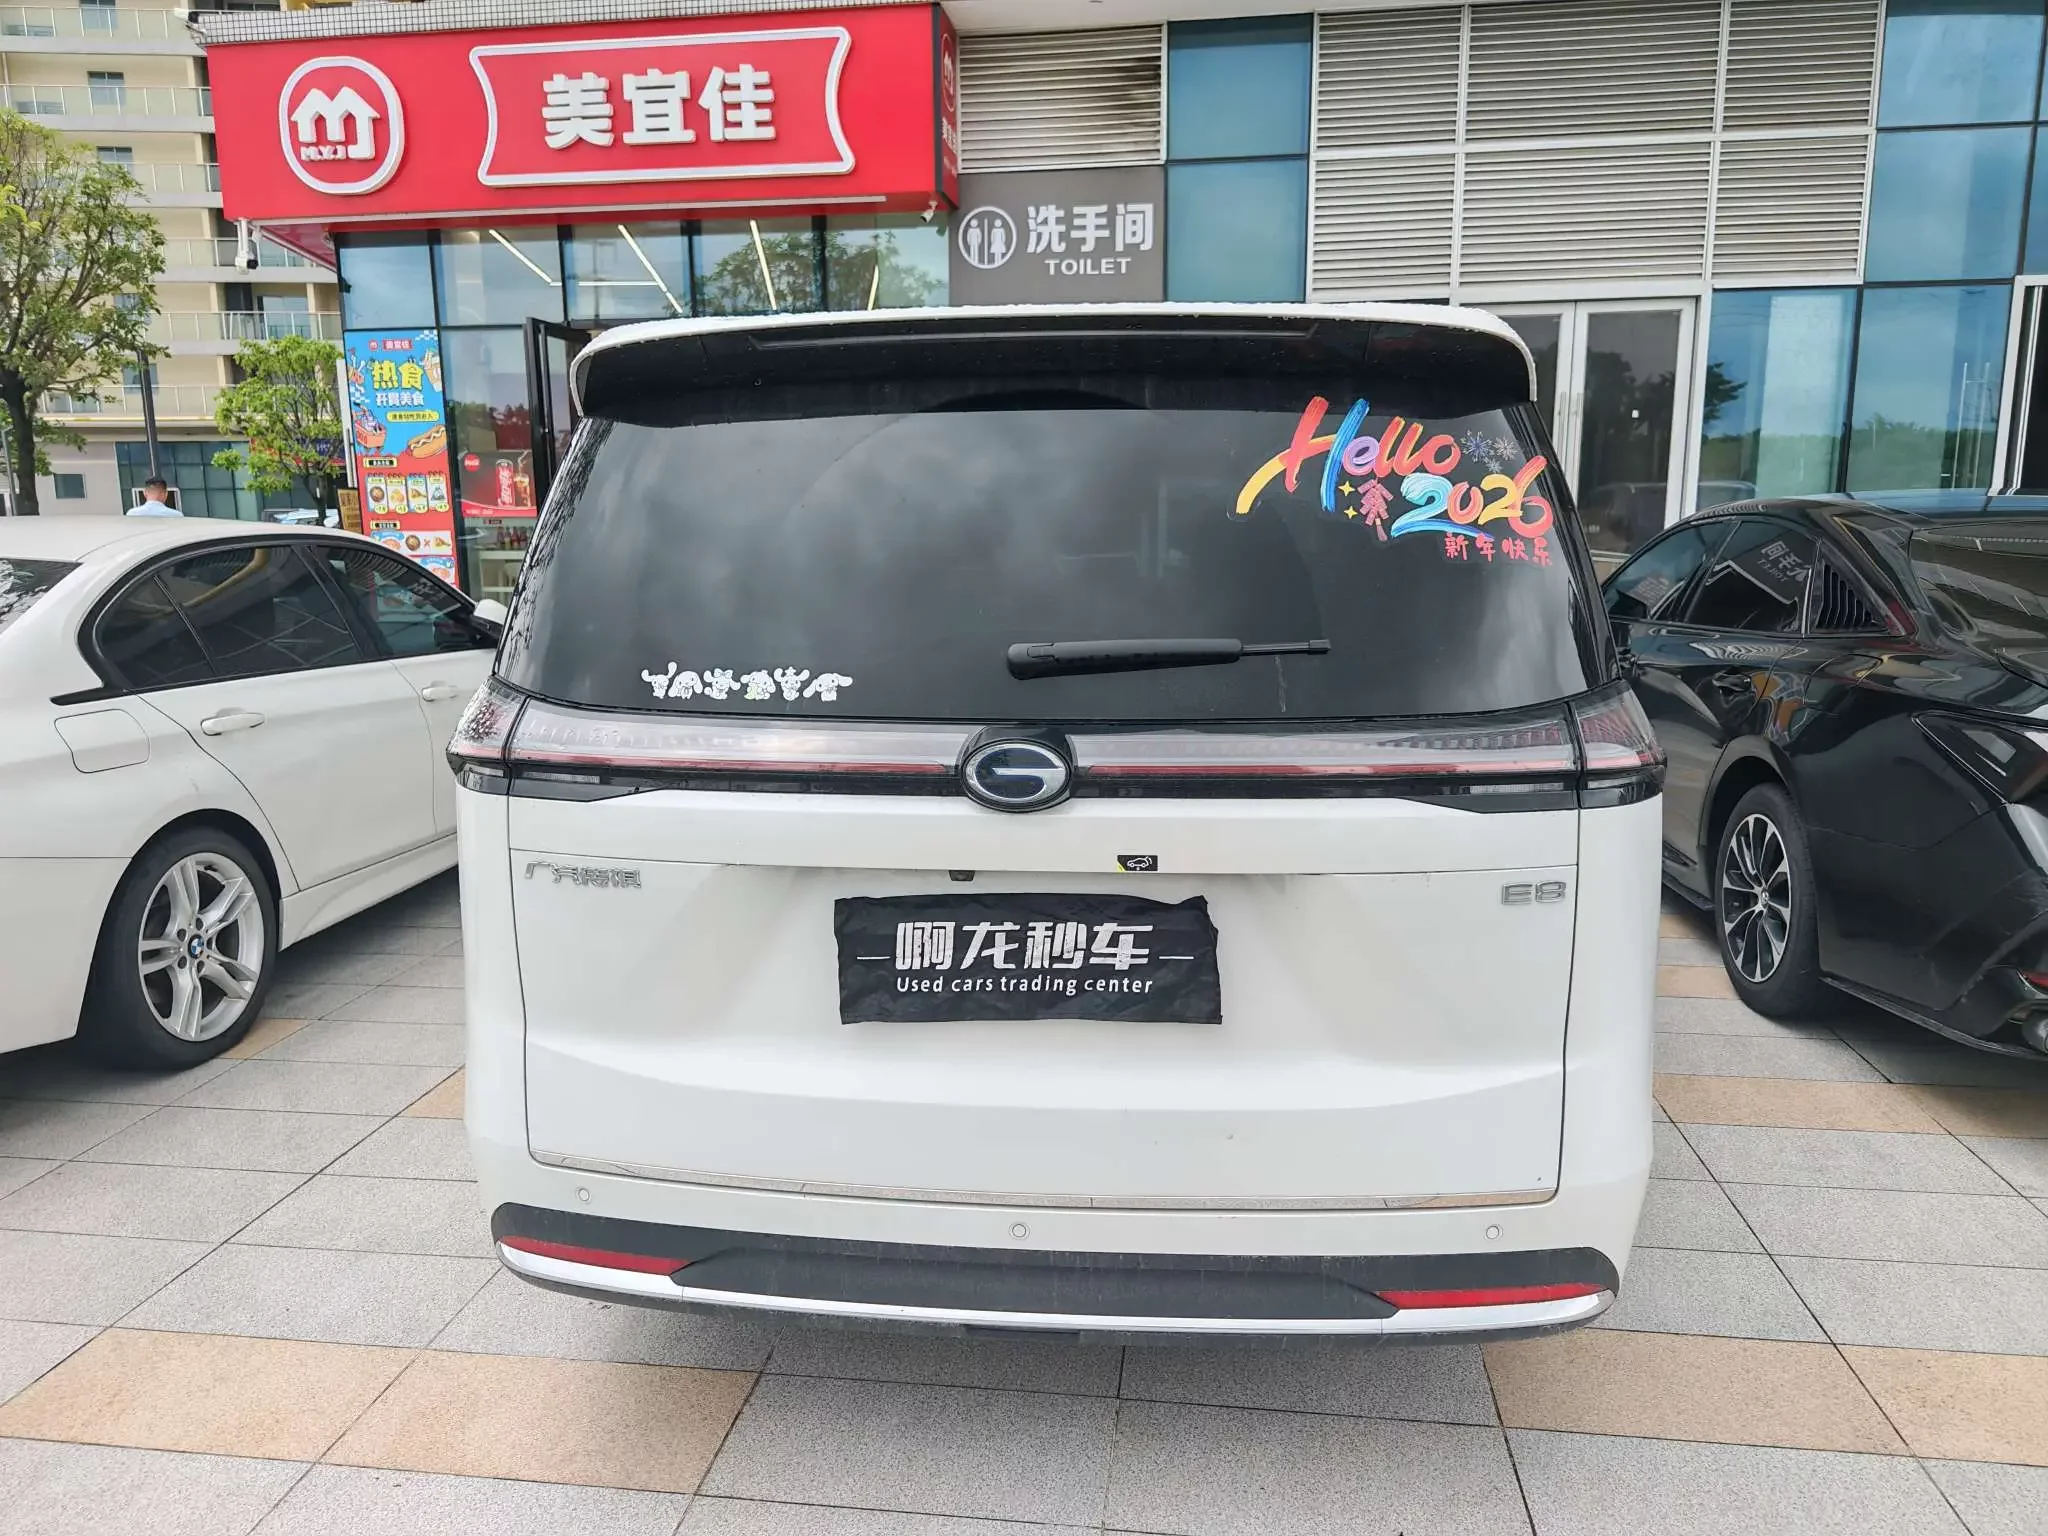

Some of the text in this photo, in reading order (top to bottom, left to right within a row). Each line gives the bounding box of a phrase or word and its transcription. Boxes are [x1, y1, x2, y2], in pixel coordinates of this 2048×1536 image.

[542, 62, 776, 150] 美宜佳
[1026, 203, 1154, 254] 洗手间
[1044, 257, 1132, 275] TOILET
[372, 359, 423, 390] 热食
[1236, 395, 1461, 513] Hello
[1390, 455, 1554, 539] 2026
[1443, 532, 1553, 567] 新年快乐
[1502, 881, 1566, 905] E8
[895, 921, 1153, 971] 啊龙秒车
[896, 974, 1153, 995] Used cars trading center
